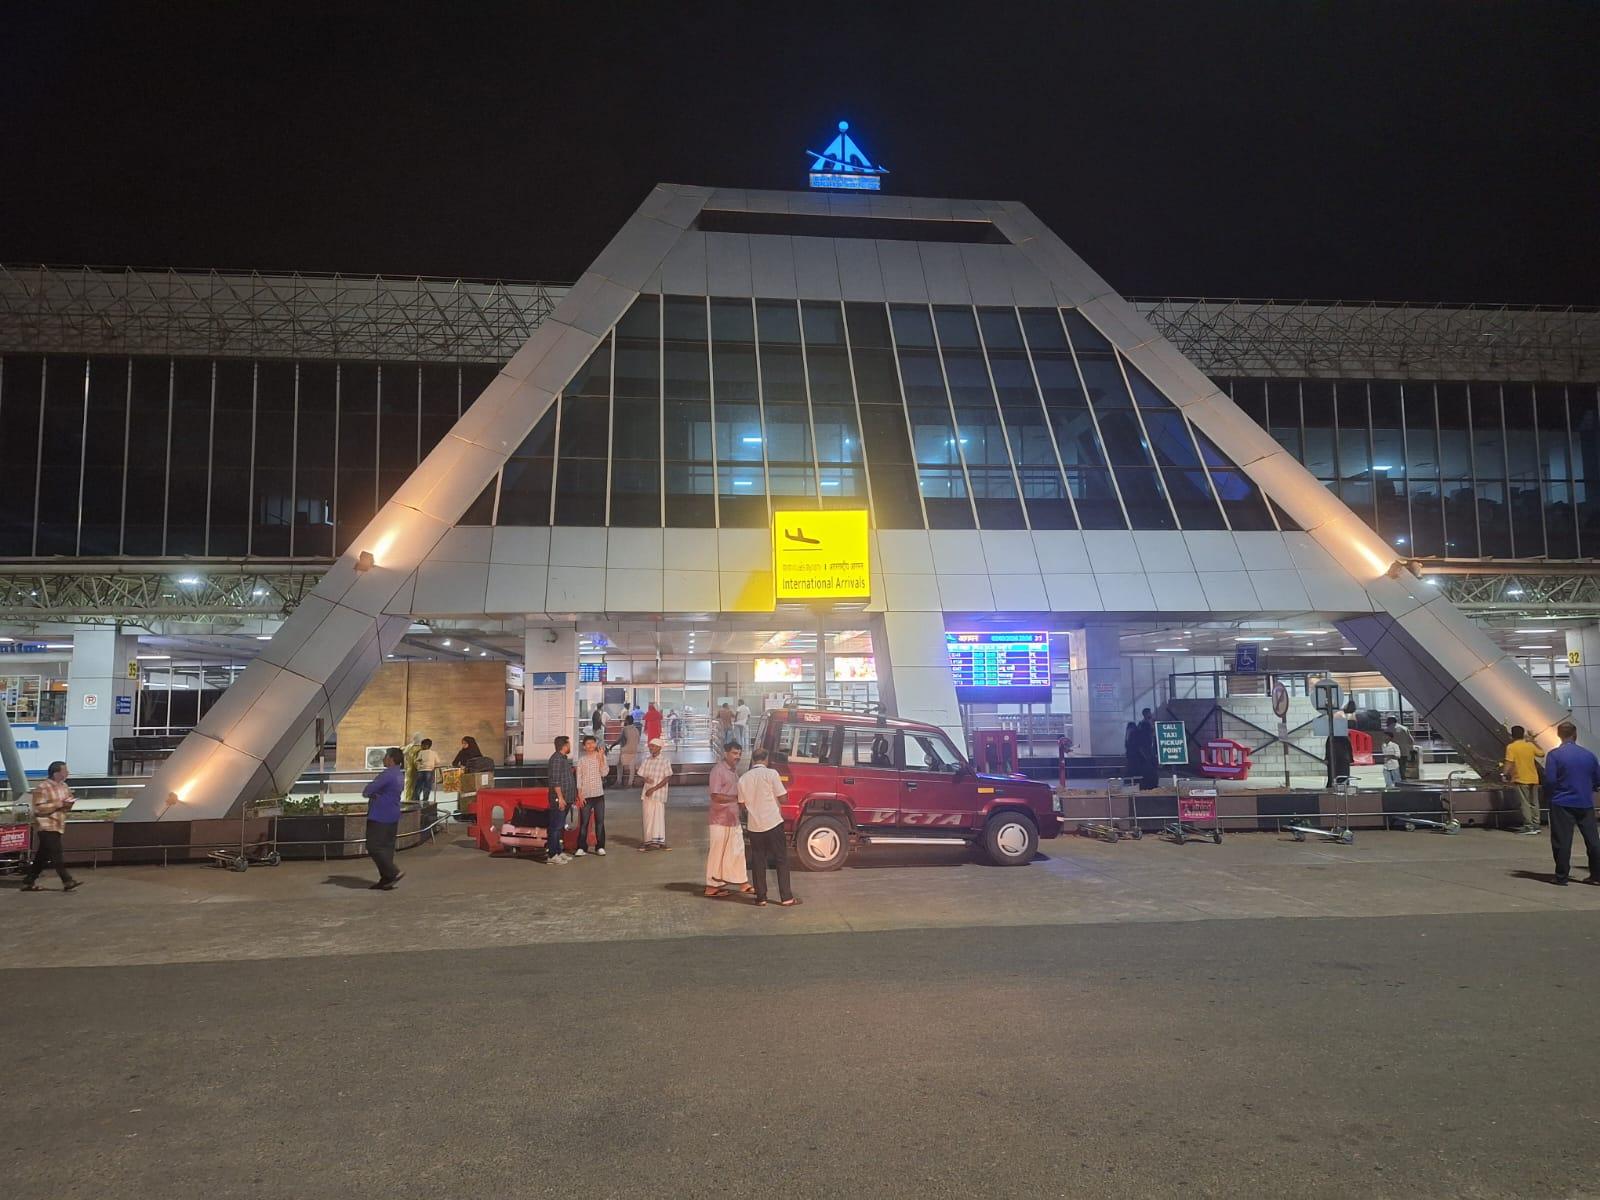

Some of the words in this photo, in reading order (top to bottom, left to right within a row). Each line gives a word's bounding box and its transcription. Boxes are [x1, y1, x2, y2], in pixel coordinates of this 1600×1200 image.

[783, 576, 834, 590] International
[836, 576, 866, 589] Arrivals
[1569, 652, 1579, 664] 32
[128, 663, 136, 676] 35
